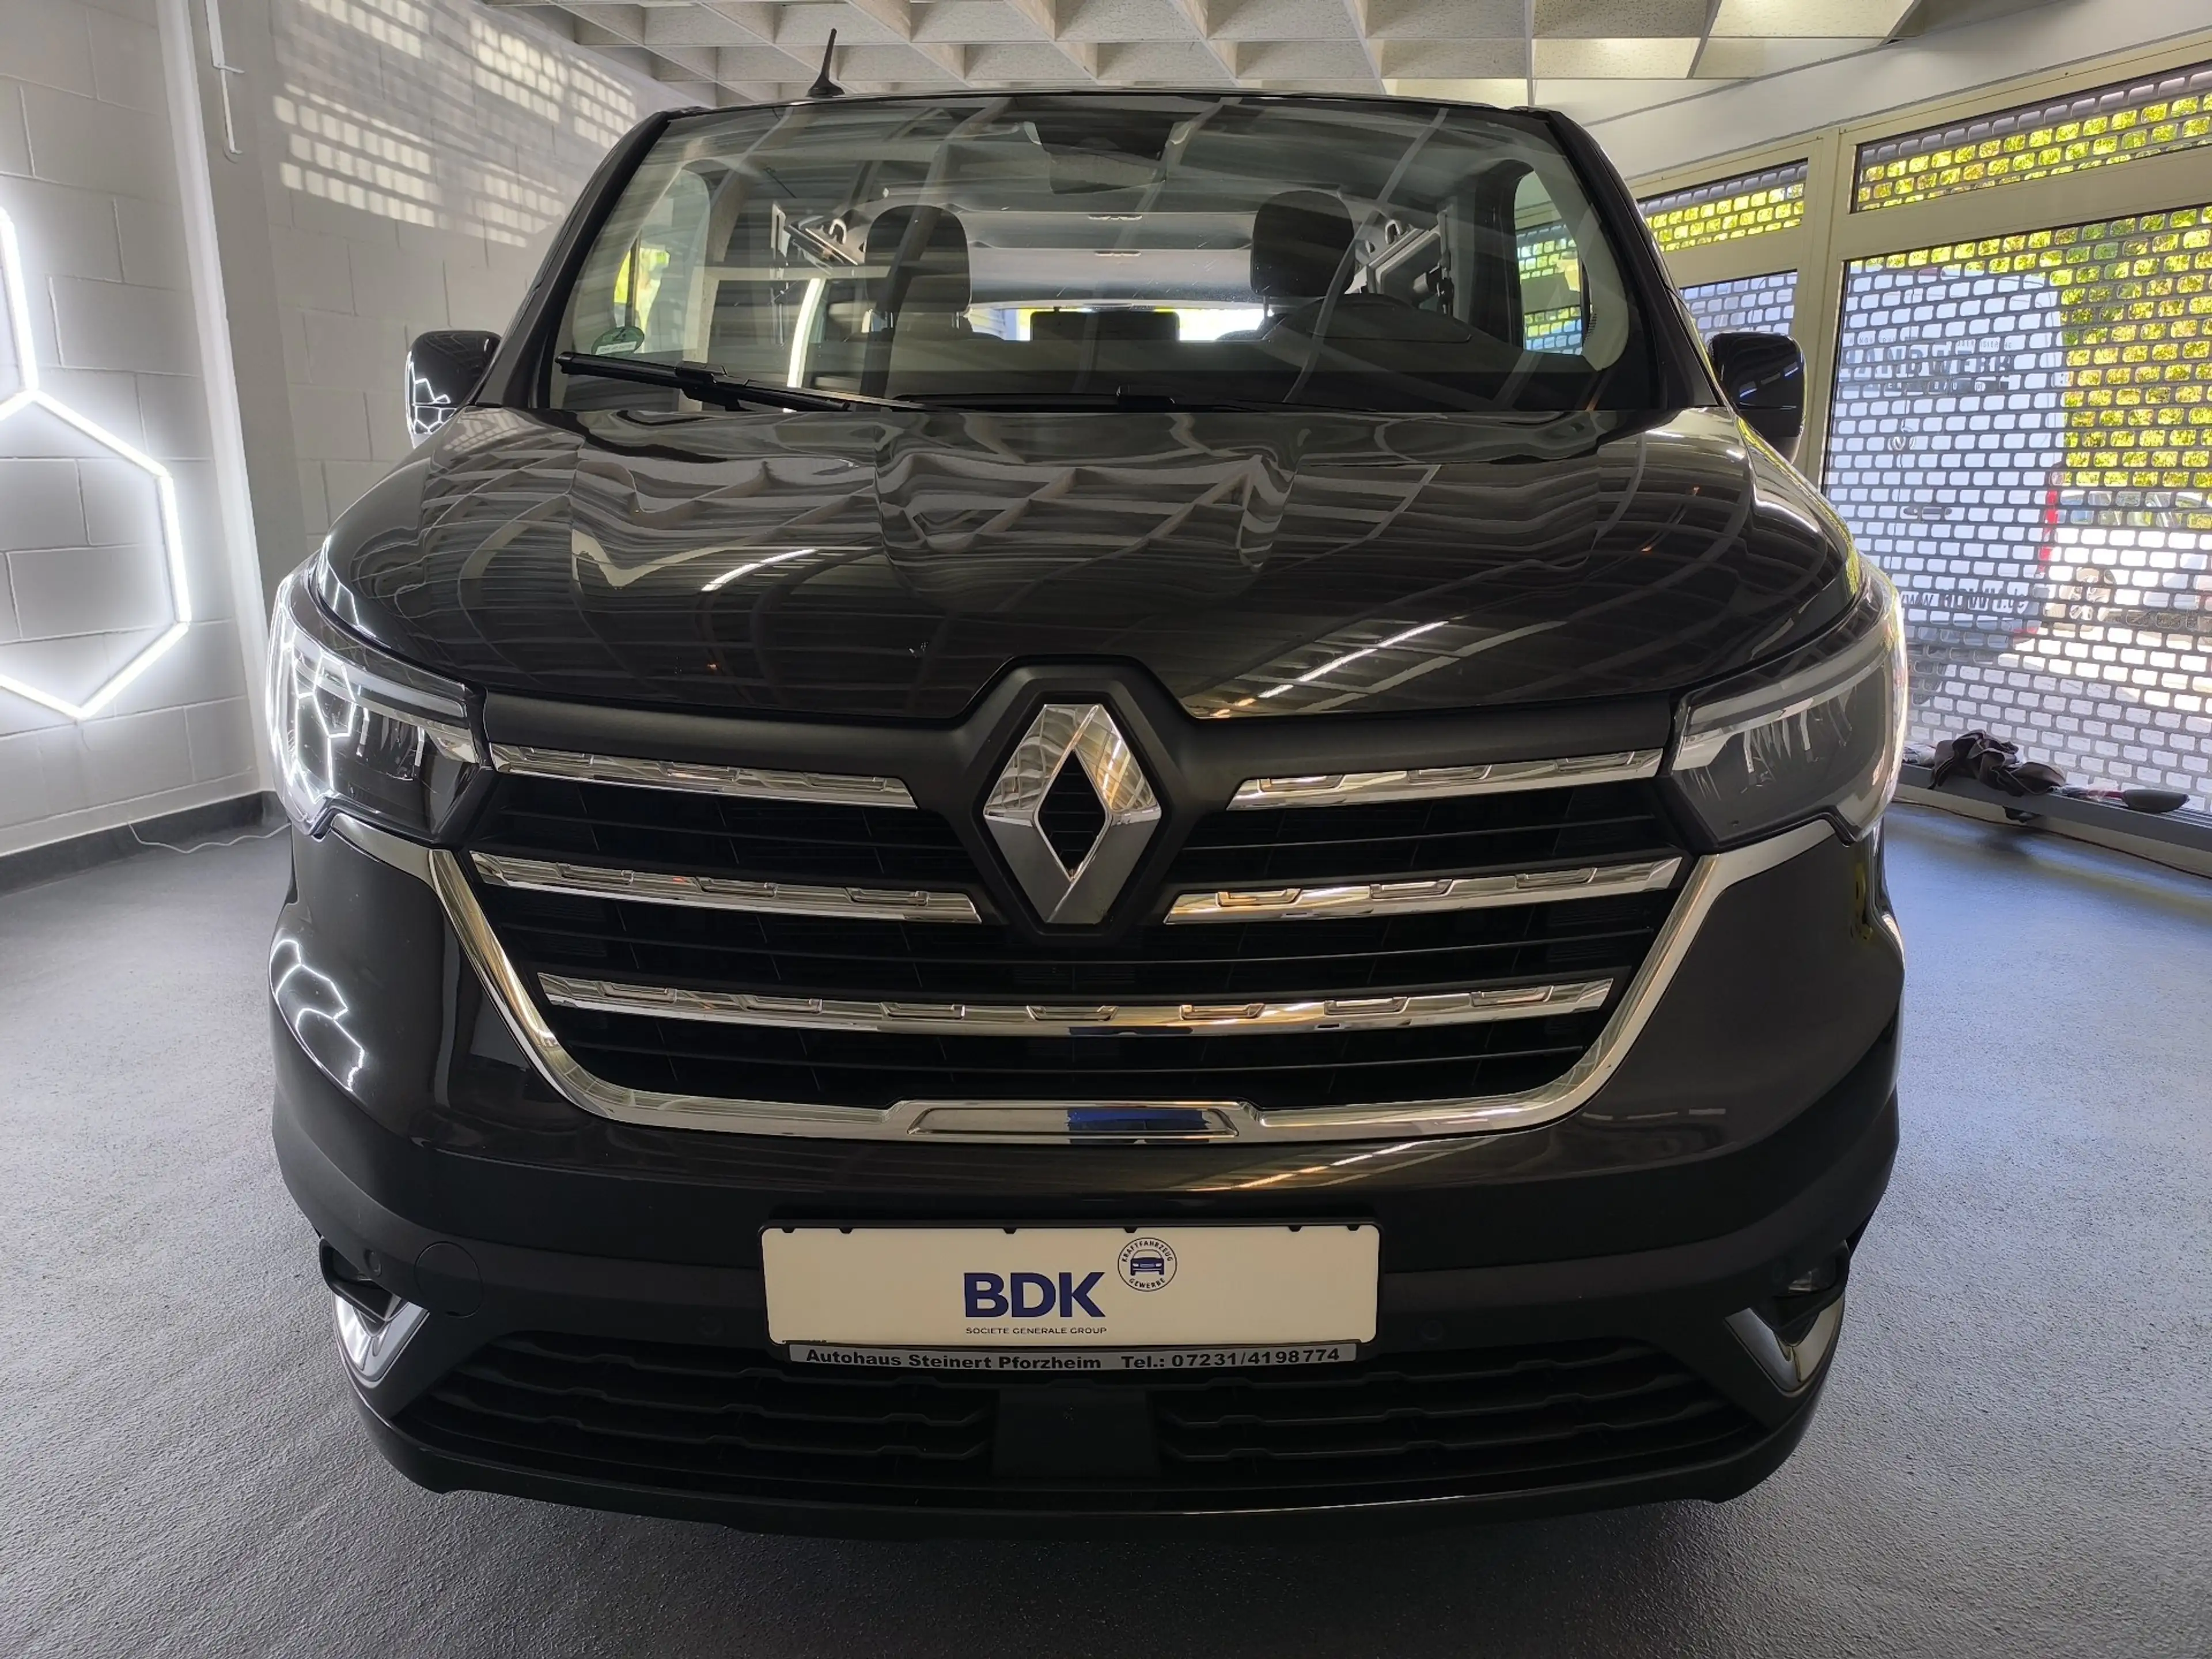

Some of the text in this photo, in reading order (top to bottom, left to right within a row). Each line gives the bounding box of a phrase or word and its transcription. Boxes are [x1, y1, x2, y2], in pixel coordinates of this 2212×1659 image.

[1122, 1240, 1173, 1263] KRAFTFAHRZEUG
[964, 1271, 1106, 1317] BDK
[1129, 1277, 1166, 1289] GEWERBE
[806, 1347, 1340, 1369] Autohaus Steinert Pforzheim Tel.: 07231/4198774
